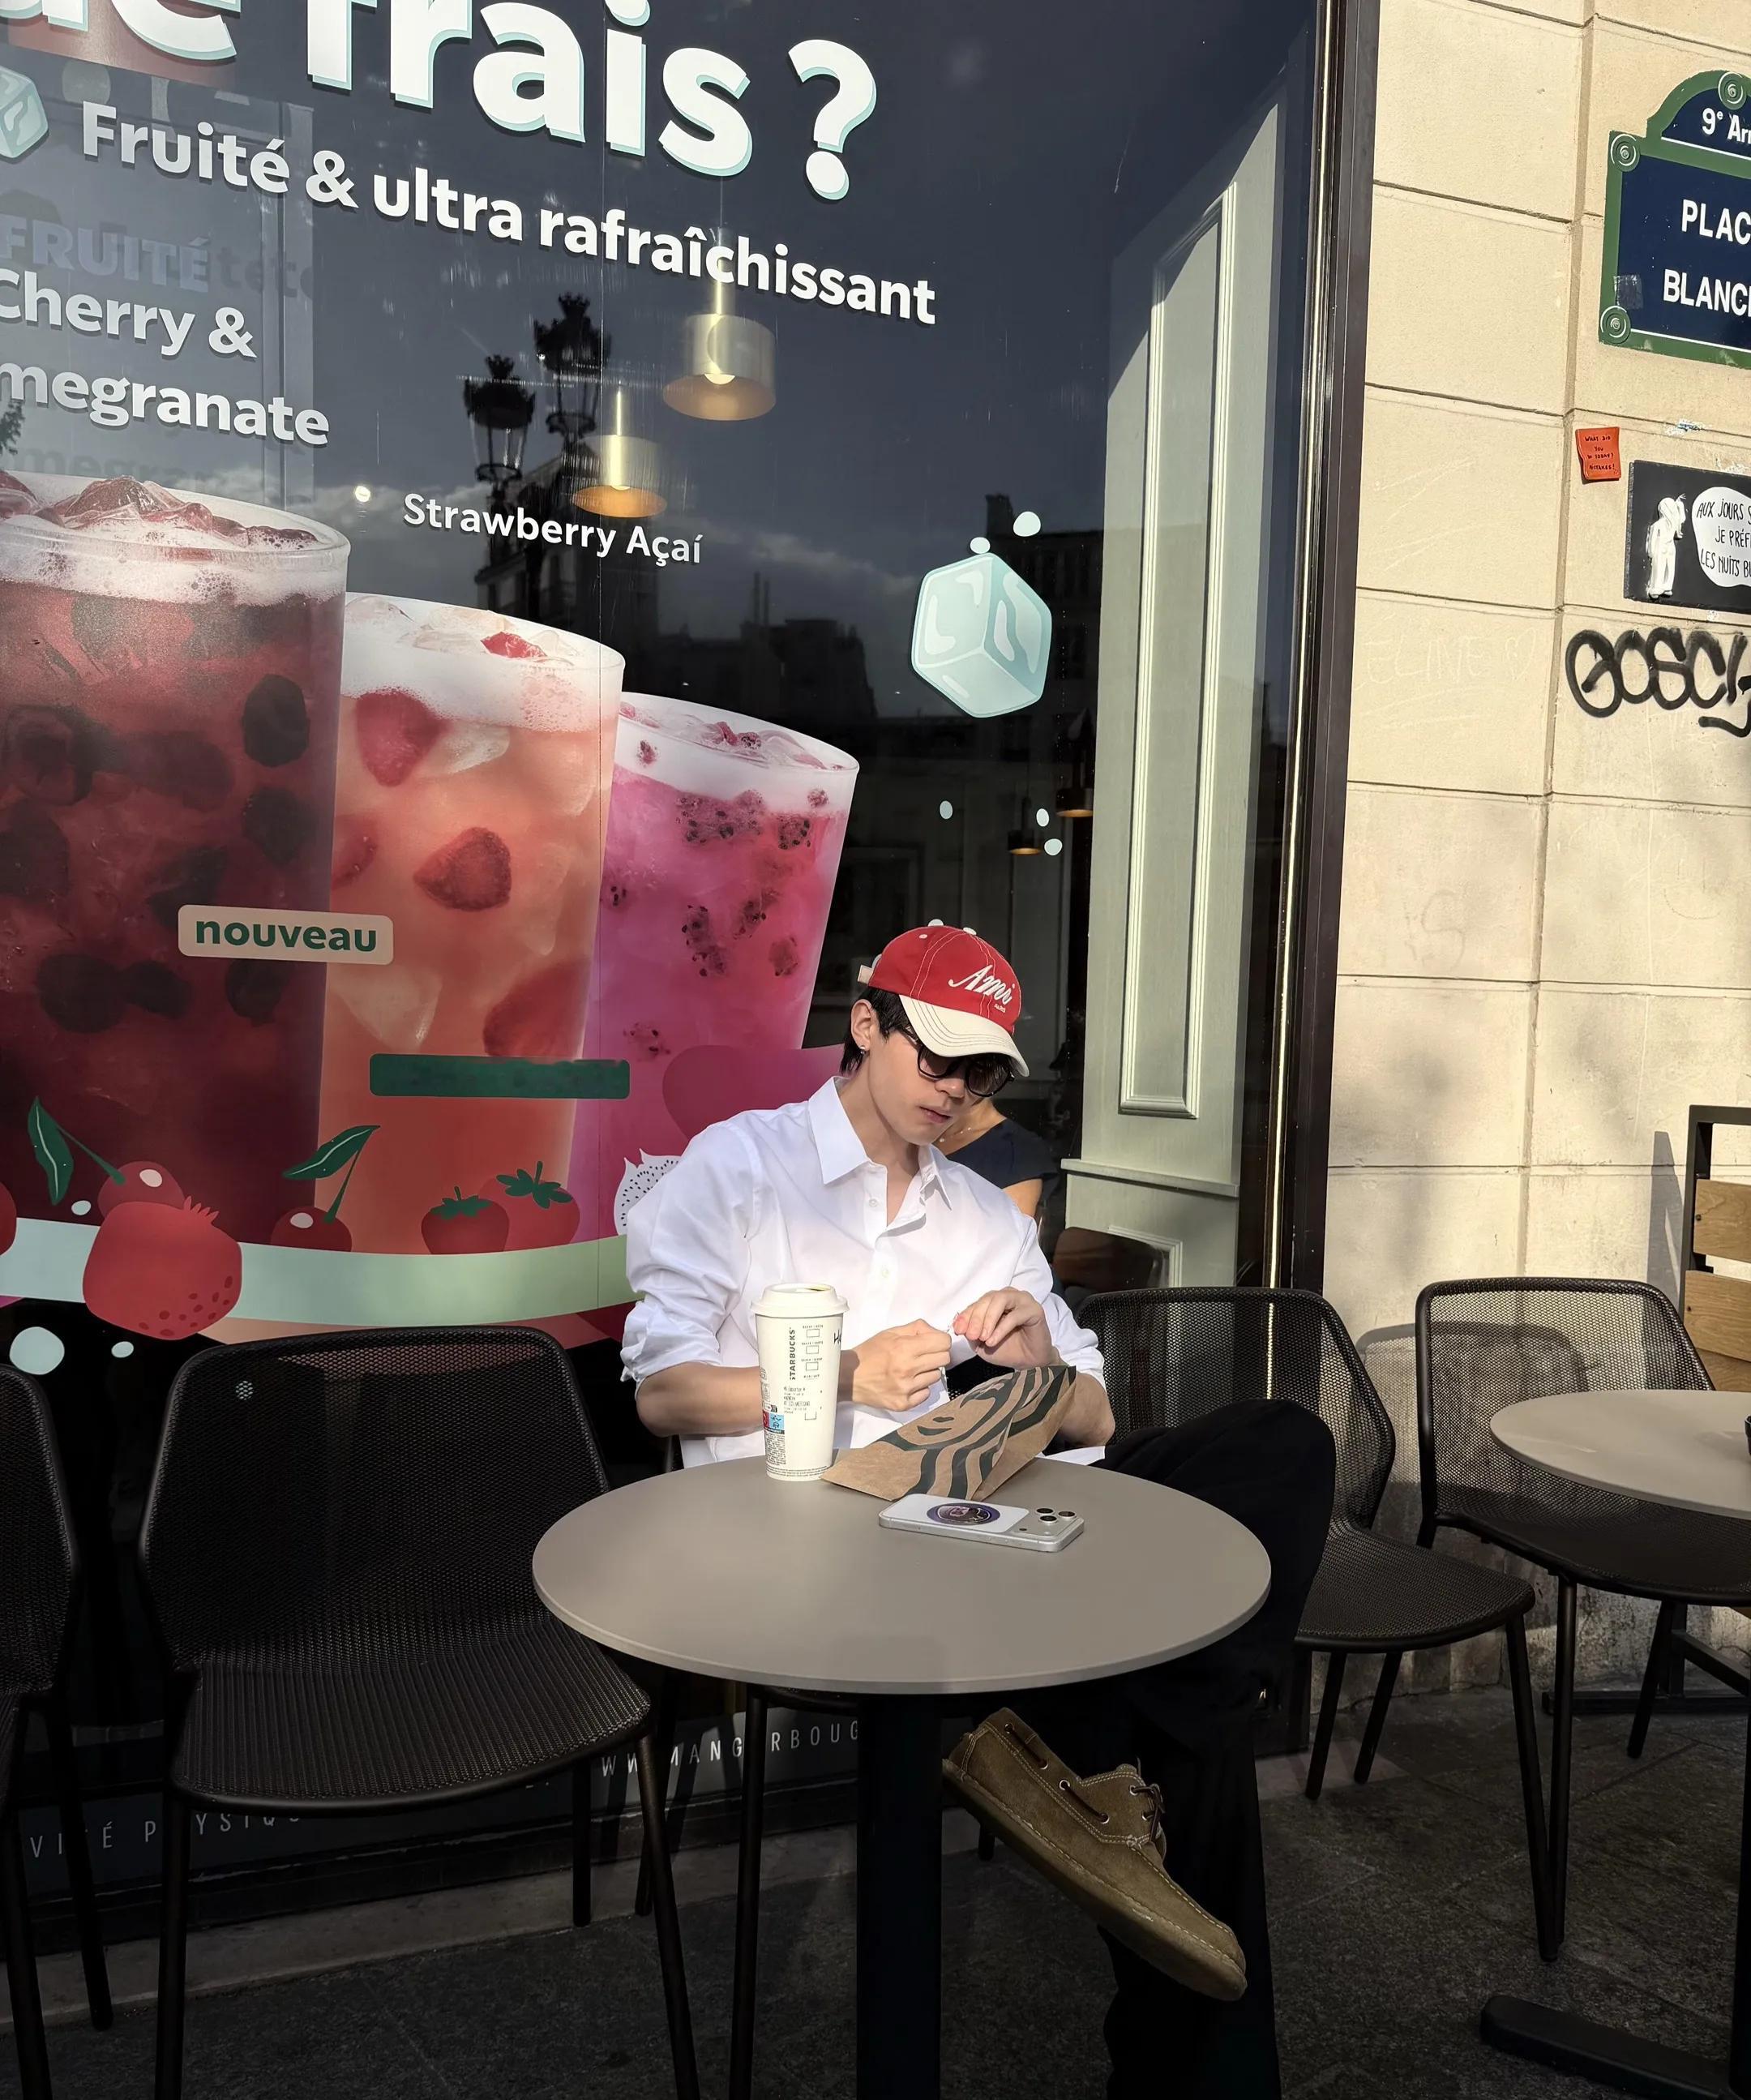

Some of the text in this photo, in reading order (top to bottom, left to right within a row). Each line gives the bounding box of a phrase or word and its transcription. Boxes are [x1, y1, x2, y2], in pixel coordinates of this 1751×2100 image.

[788, 39, 877, 200] ?
[83, 101, 936, 325] Fruité & ultra rafraîchissant
[0, 268, 195, 357] Cherry
[208, 306, 258, 358] &
[1663, 268, 1751, 318] BLANC
[0, 362, 330, 445] megranate
[404, 492, 704, 568] Strawberry Açaí
[1696, 501, 1715, 518] AUX
[1729, 528, 1751, 548] PRÉF
[1700, 548, 1715, 570] LES
[195, 919, 378, 954] nouveau
